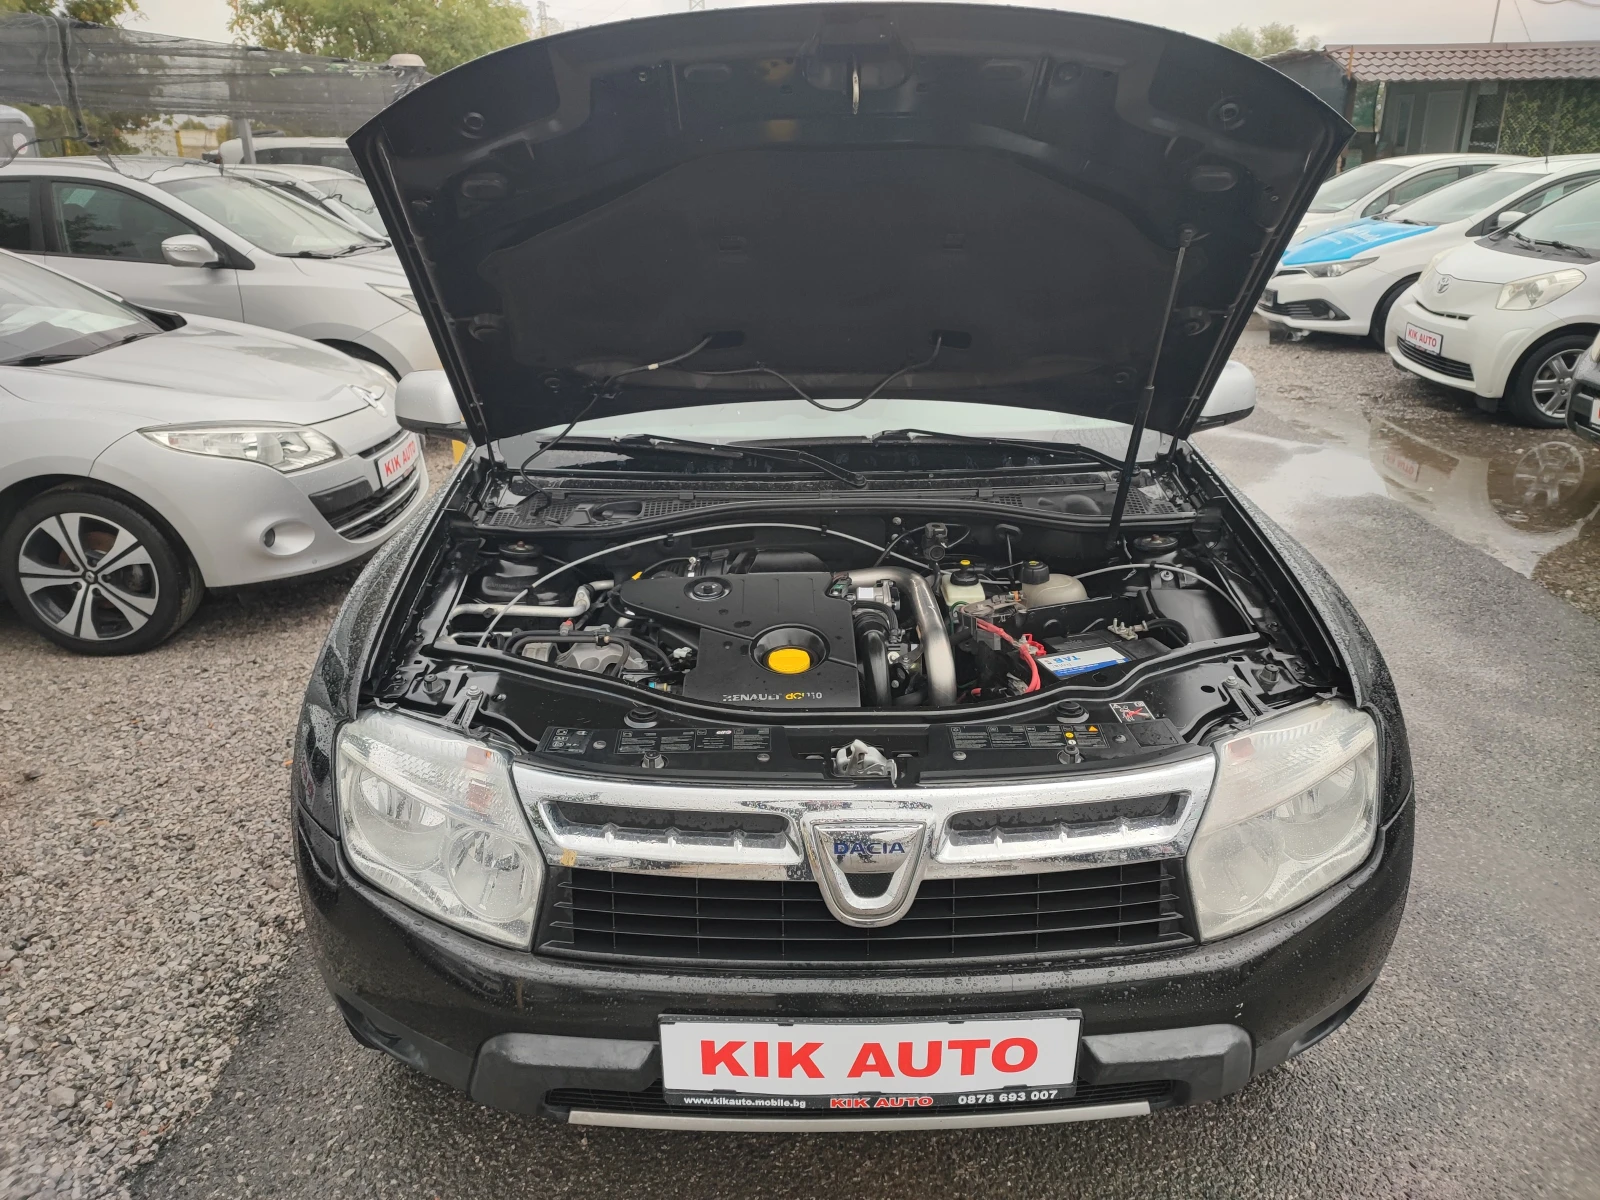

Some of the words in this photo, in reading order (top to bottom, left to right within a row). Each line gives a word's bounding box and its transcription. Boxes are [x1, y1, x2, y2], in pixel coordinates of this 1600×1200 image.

[1408, 328, 1418, 341] KIK
[1419, 333, 1437, 348] AUTO
[384, 454, 402, 477] KIK
[402, 440, 416, 464] AUTO
[833, 841, 905, 855] DACIA
[700, 1039, 825, 1079] KIK
[847, 1037, 1039, 1078] AUTO
[683, 1096, 806, 1109] www.kikauto.mobile.bg
[829, 1097, 870, 1108] KIK
[873, 1096, 934, 1108] AUTO
[958, 1094, 995, 1105] 0878
[999, 1092, 1027, 1102] 693
[1030, 1090, 1058, 1101] 007
